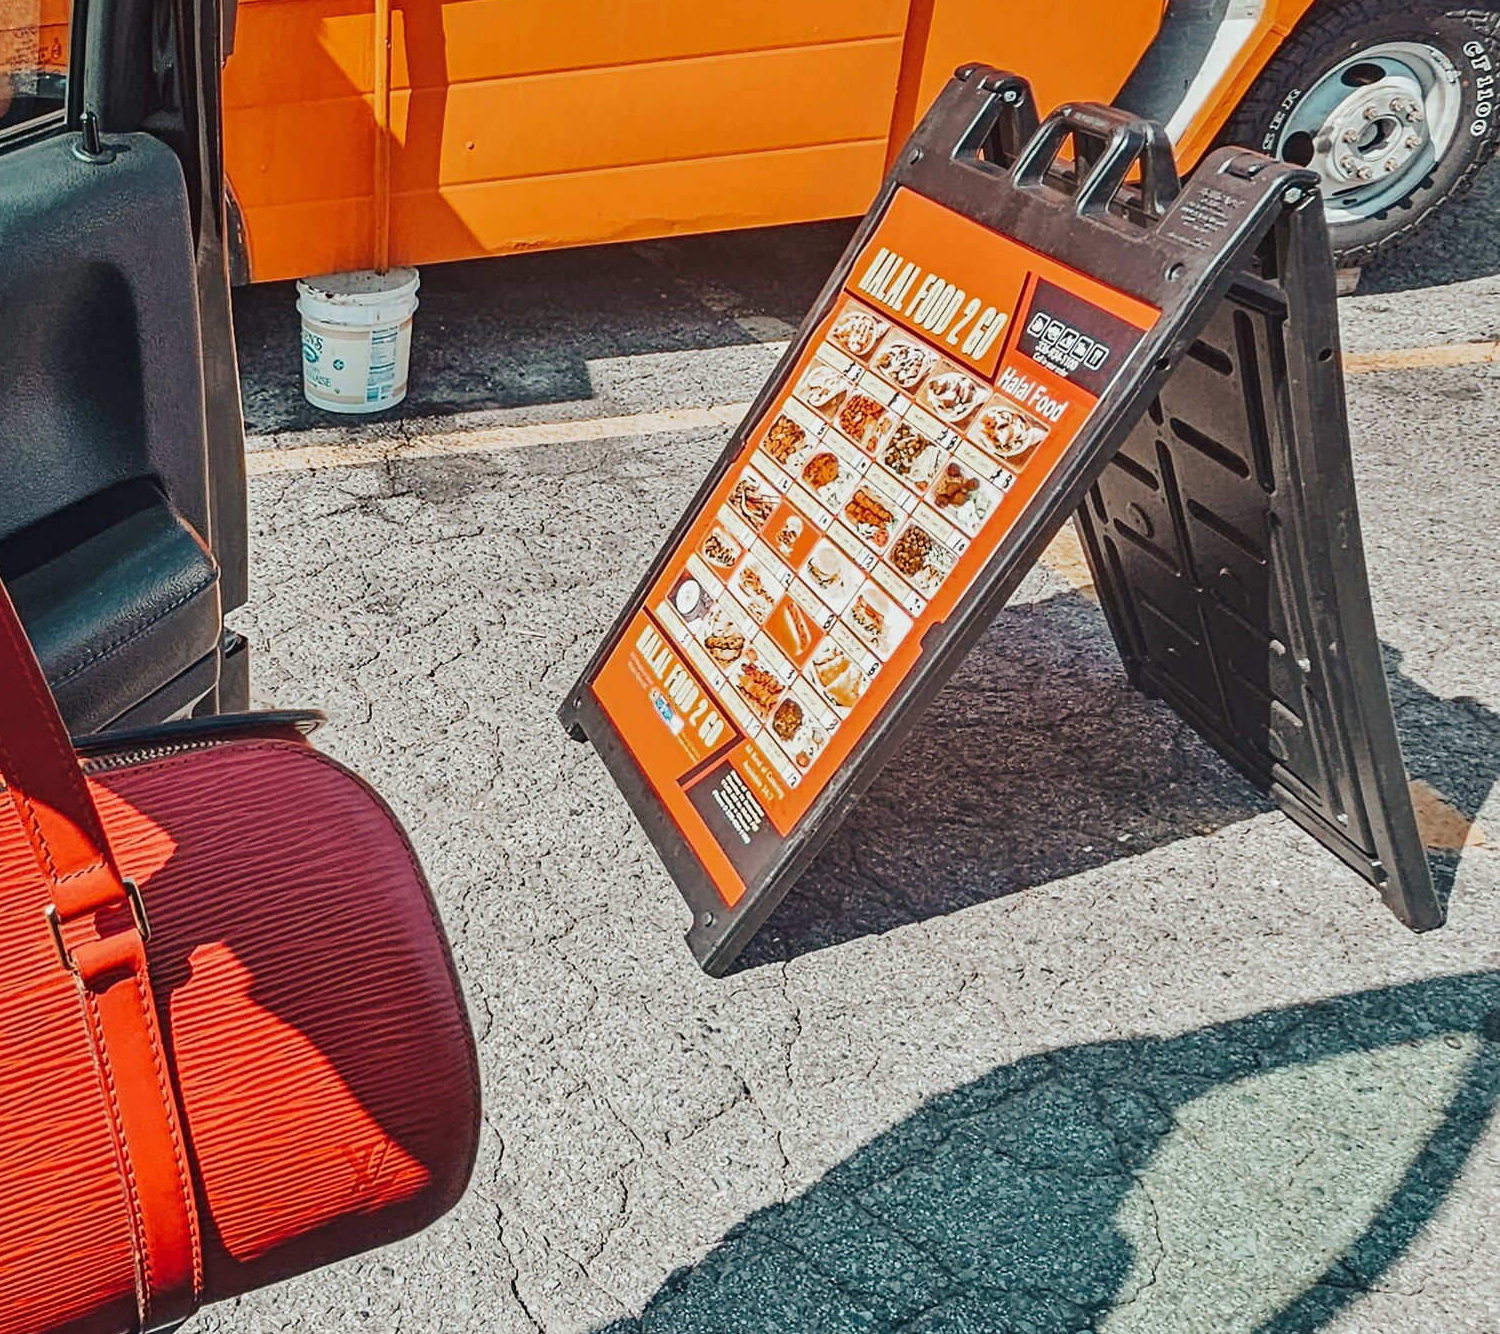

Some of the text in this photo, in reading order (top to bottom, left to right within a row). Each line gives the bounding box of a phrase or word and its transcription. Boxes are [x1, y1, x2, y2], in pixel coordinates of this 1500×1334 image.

[858, 247, 1008, 361] HALAL FOOD 2 GO
[996, 366, 1069, 422] Halal Food
[636, 624, 674, 680] HALAL
[664, 663, 699, 713] FOOD
[689, 699, 708, 727] 2
[698, 711, 724, 747] GO
